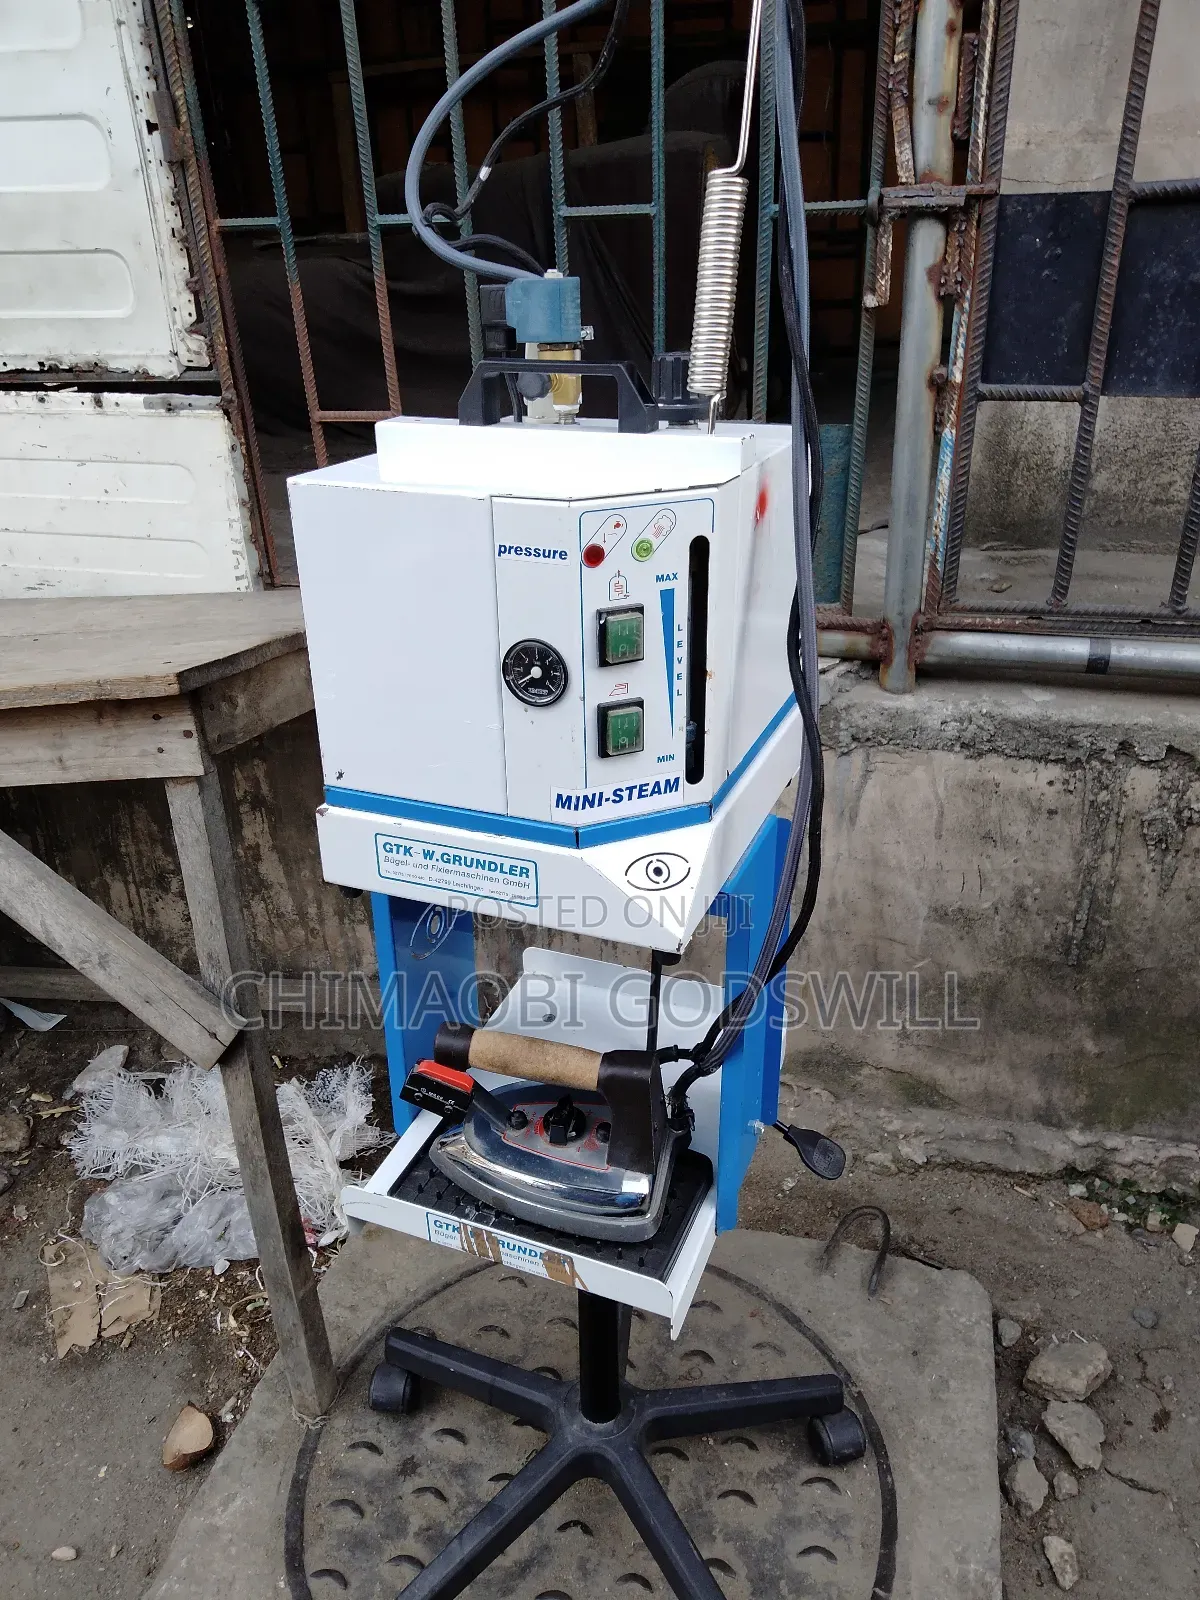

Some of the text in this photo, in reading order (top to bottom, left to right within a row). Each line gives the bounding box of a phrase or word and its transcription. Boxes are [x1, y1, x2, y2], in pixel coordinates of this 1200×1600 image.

[497, 543, 568, 561] pressure
[655, 572, 678, 583] MAX
[656, 753, 675, 763] MIN
[555, 776, 680, 811] MINI-STEAM
[412, 860, 429, 870] und
[502, 874, 530, 890] GmbH
